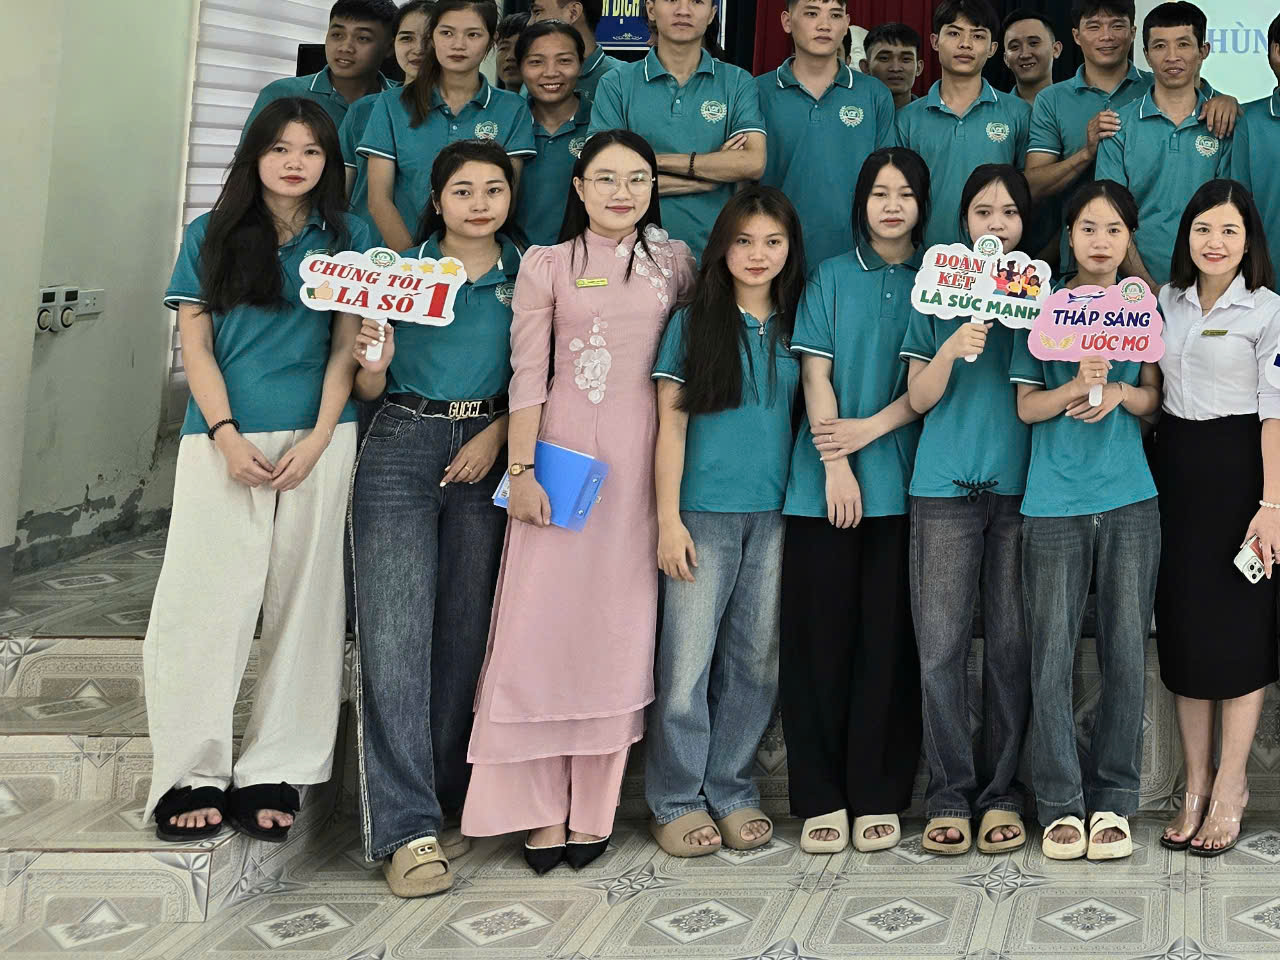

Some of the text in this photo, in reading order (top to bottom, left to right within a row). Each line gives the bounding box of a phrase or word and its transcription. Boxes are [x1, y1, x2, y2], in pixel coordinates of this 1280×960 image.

[1207, 21, 1268, 53] HÙN
[934, 252, 985, 273] ĐOÀN
[309, 259, 423, 291] CHÚNG TÔI
[937, 271, 976, 290] KẾT
[334, 282, 450, 319] LÀ SỐ 1
[920, 289, 1041, 320] LÀ SỨC MẠNH
[1053, 305, 1150, 327] THẮP SÁNG
[1081, 331, 1149, 351] ƯỚC MƠ
[448, 401, 482, 417] GUCCI
